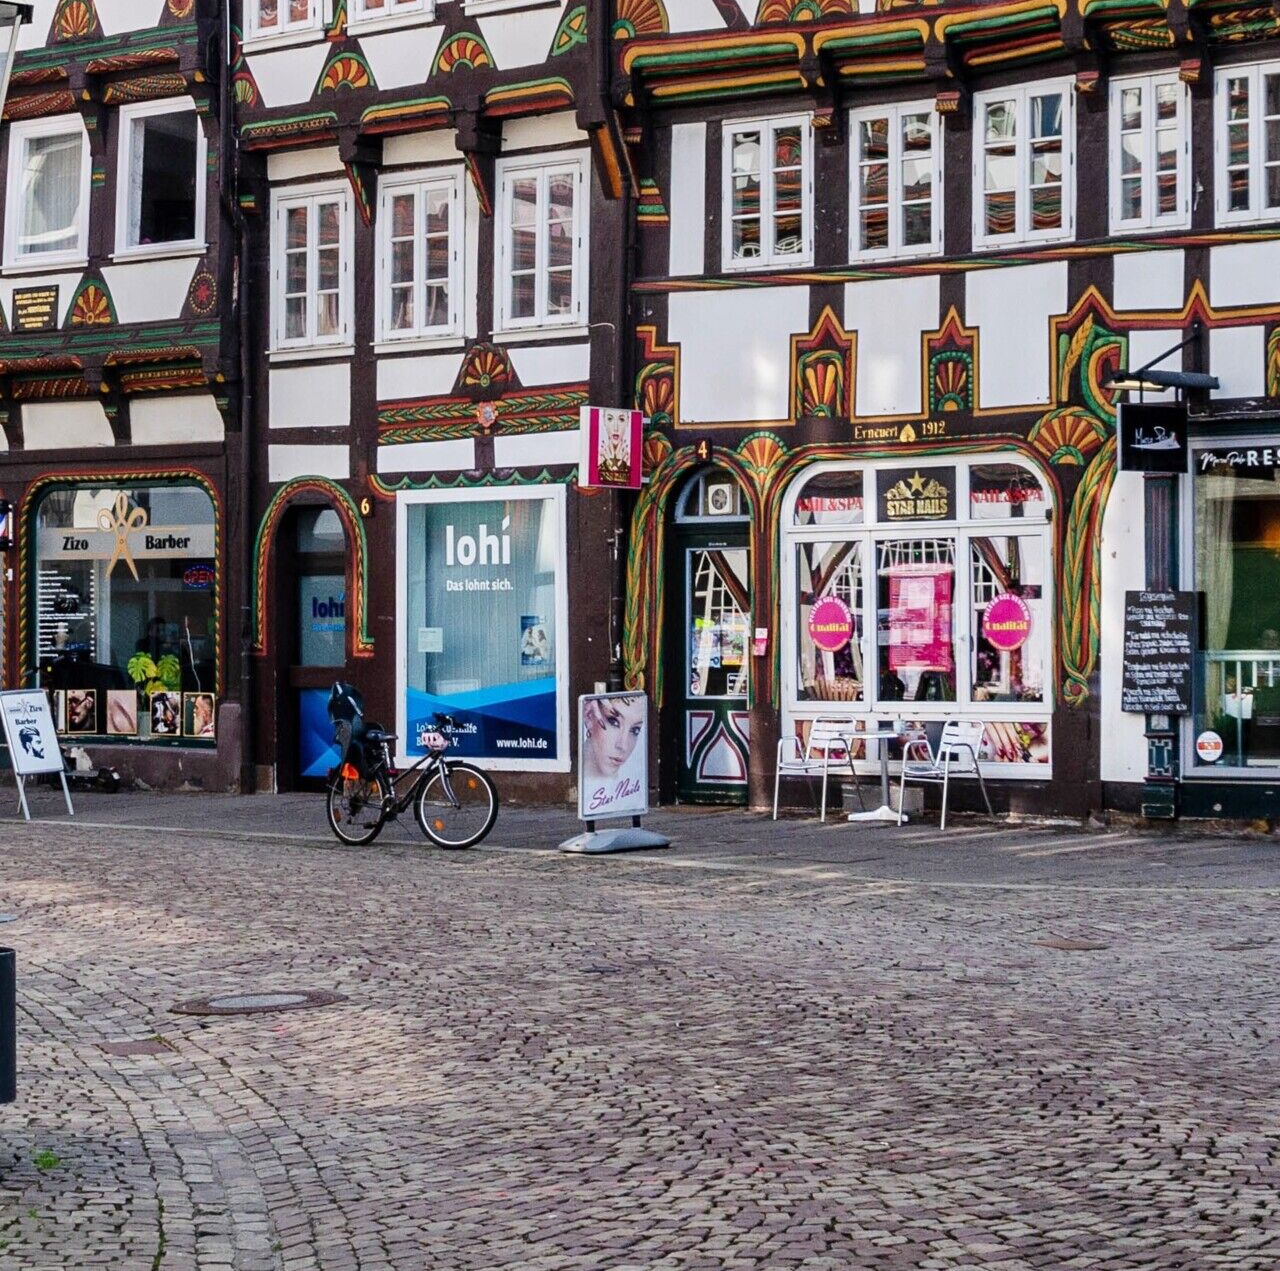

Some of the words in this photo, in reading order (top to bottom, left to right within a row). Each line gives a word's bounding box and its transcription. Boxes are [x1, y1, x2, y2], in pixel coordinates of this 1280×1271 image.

[922, 420, 945, 435] 1912
[698, 441, 707, 459] 4
[971, 487, 1044, 505] NAIL&SPA
[361, 497, 369, 515] 6
[886, 501, 916, 517] STAR
[917, 498, 949, 515] NAILS
[62, 536, 89, 551] Zizo
[145, 534, 191, 550] Barber
[446, 580, 464, 592] Das
[465, 579, 490, 591] lohnt
[491, 578, 514, 591] sich.
[496, 736, 548, 750] www.lohi.de
[588, 787, 614, 810] Star
